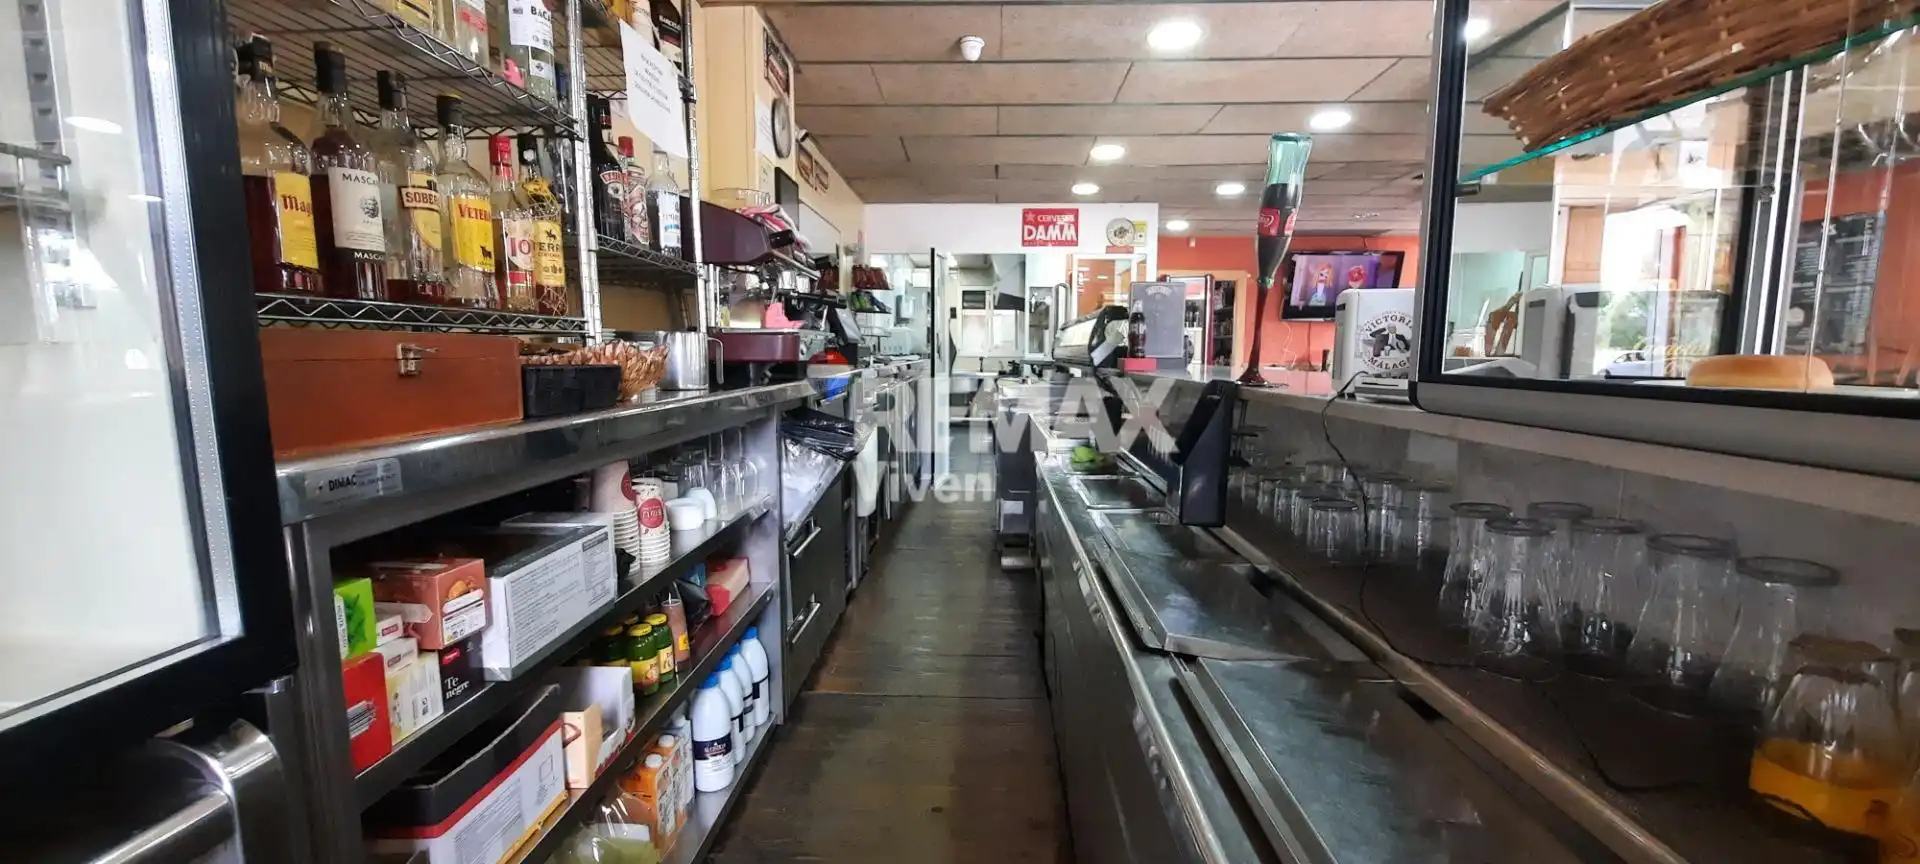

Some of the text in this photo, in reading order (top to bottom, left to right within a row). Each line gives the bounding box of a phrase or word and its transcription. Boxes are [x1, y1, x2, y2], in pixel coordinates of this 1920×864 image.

[1023, 224, 1077, 241] DAMM
[444, 676, 459, 689] Te
[446, 680, 470, 699] negre
